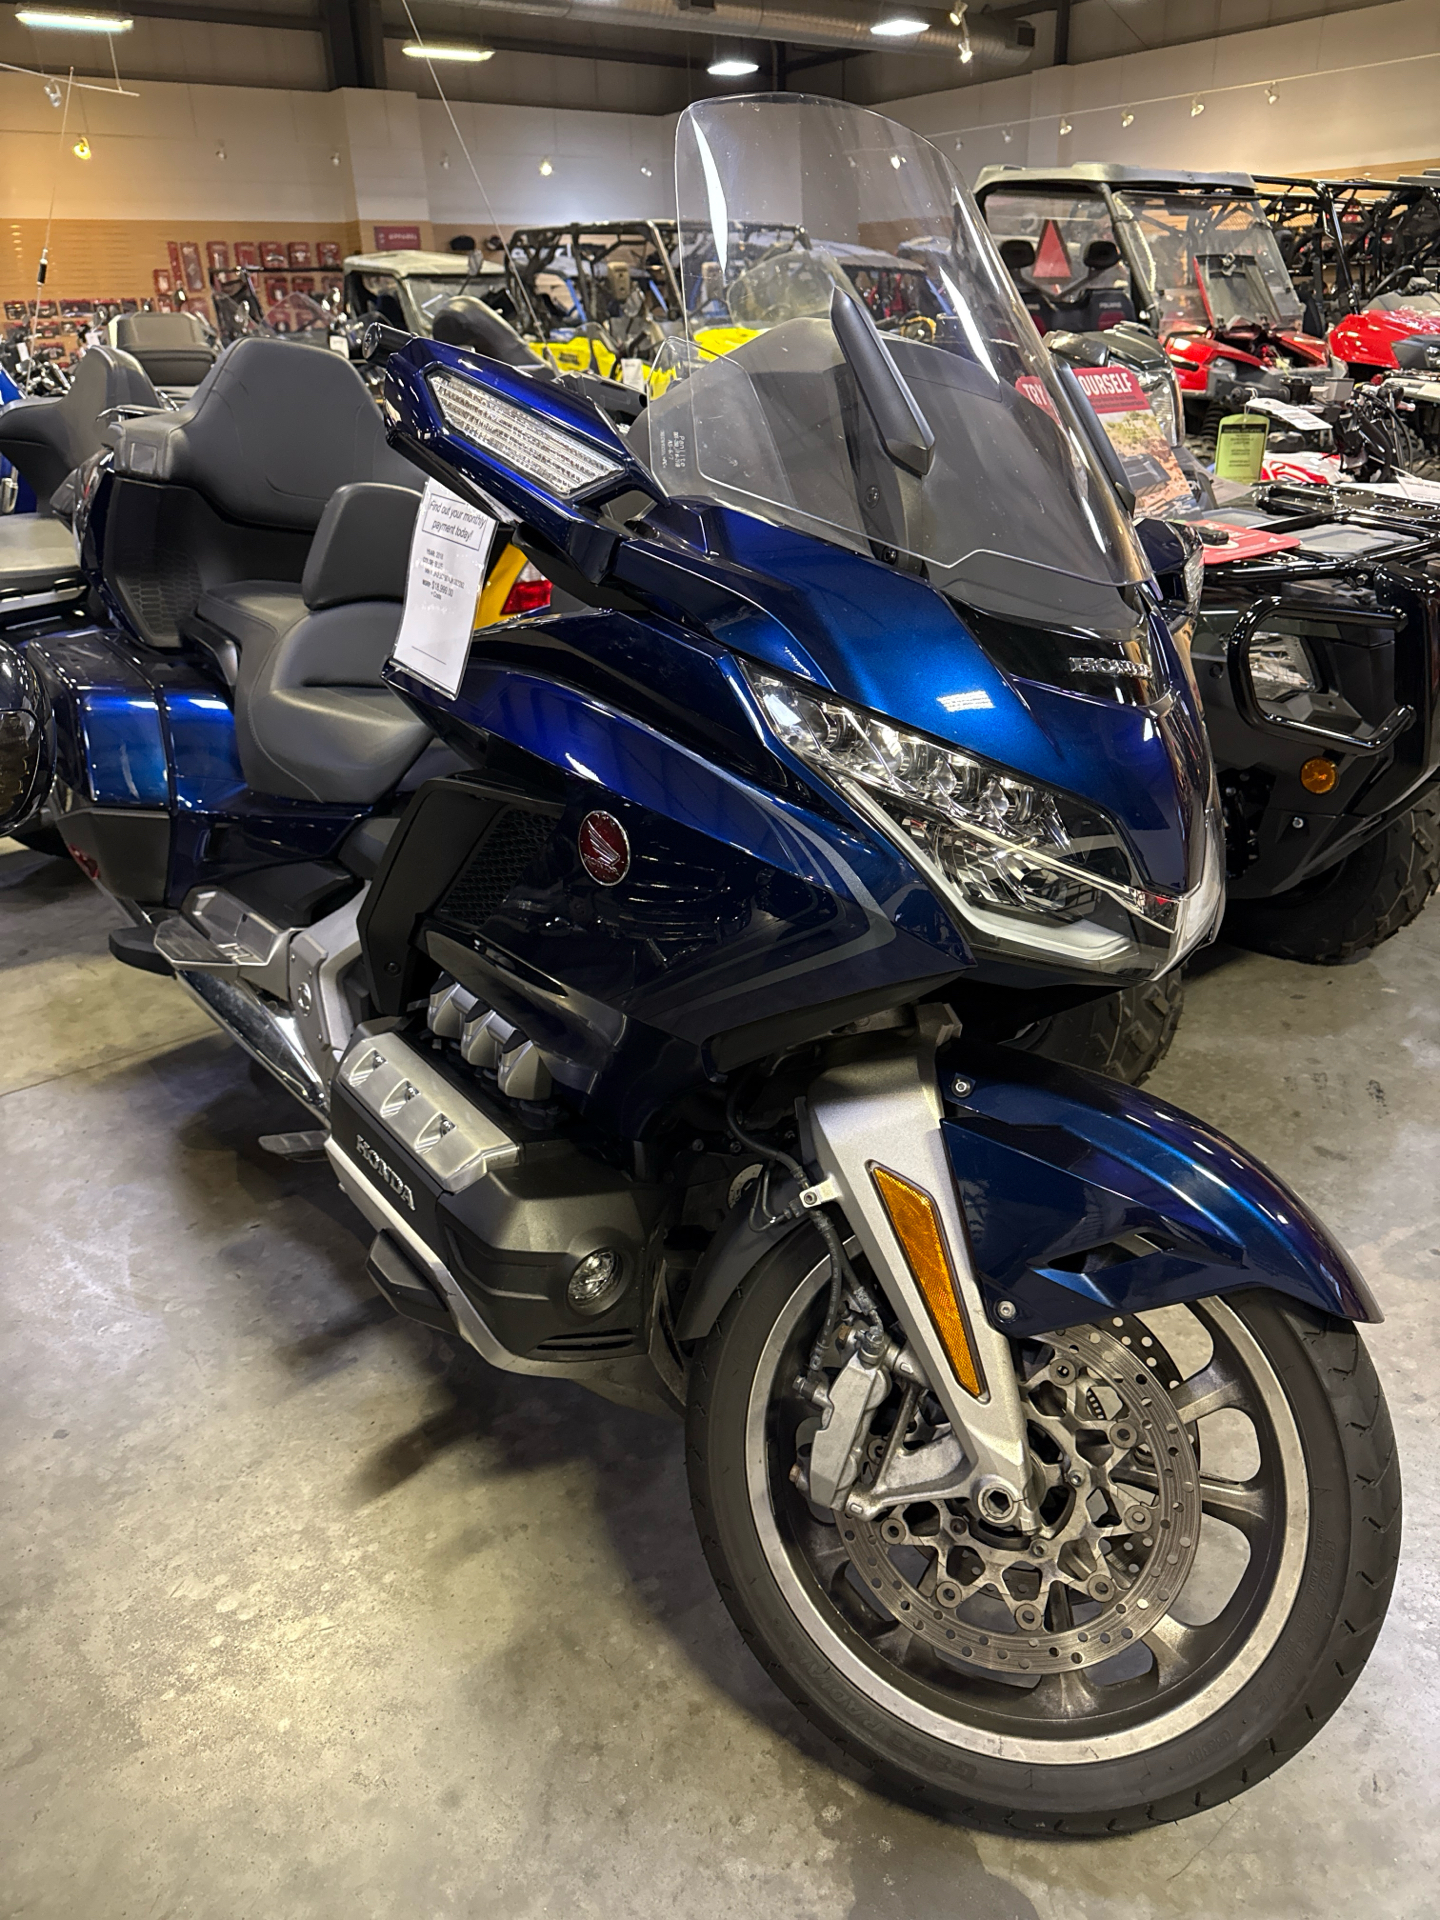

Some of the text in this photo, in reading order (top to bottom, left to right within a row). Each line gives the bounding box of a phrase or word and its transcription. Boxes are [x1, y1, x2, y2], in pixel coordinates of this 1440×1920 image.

[1022, 372, 1133, 406] TRY OURSELF
[430, 500, 486, 529] Find out your monthly
[431, 520, 474, 542] payment today!
[1069, 656, 1154, 679] HONDA
[355, 1133, 416, 1211] HONDA
